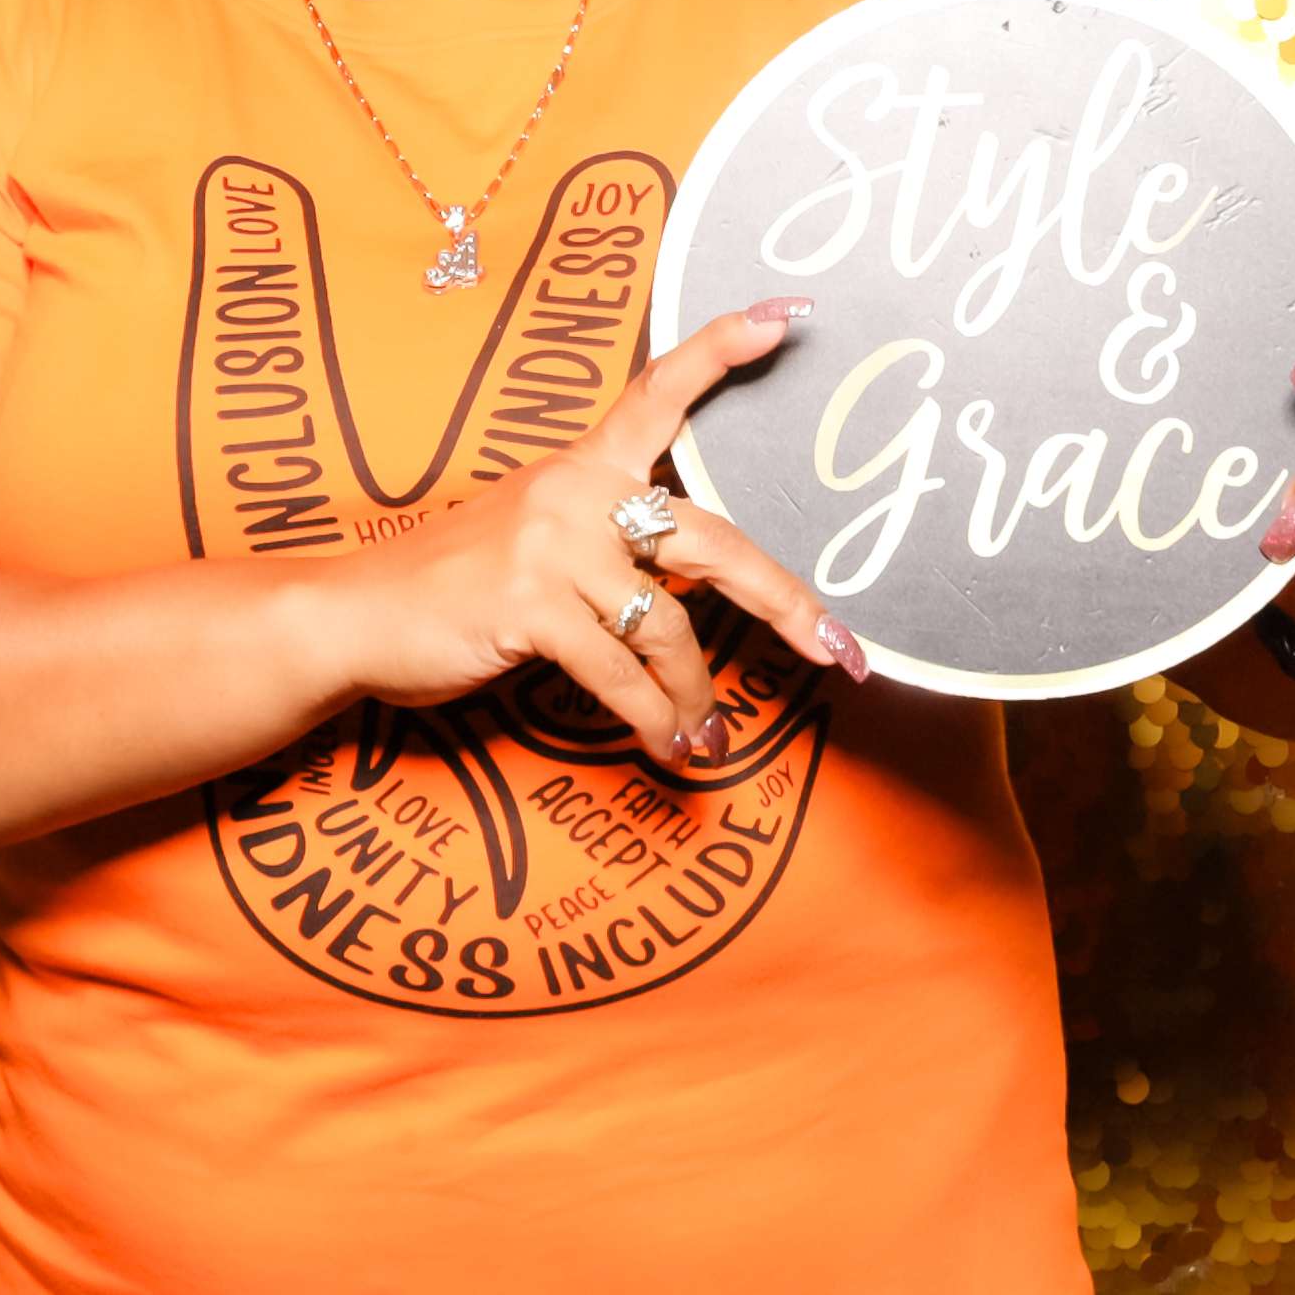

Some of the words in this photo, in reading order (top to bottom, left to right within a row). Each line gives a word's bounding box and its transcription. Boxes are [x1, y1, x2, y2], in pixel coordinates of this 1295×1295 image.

[222, 176, 282, 255] LOVE
[571, 183, 654, 218] JOY
[760, 38, 1217, 338] Style
[1099, 262, 1197, 405] &
[215, 263, 345, 553] INCLUSION
[813, 338, 1289, 598] Grace
[374, 778, 470, 858] LOVE
[527, 774, 672, 891] ACCEPT
[610, 777, 702, 851] FAITH
[757, 761, 795, 809] JOY
[314, 798, 479, 926] UNITY
[523, 875, 616, 941] PEACE
[537, 803, 783, 996] INCLUDE
